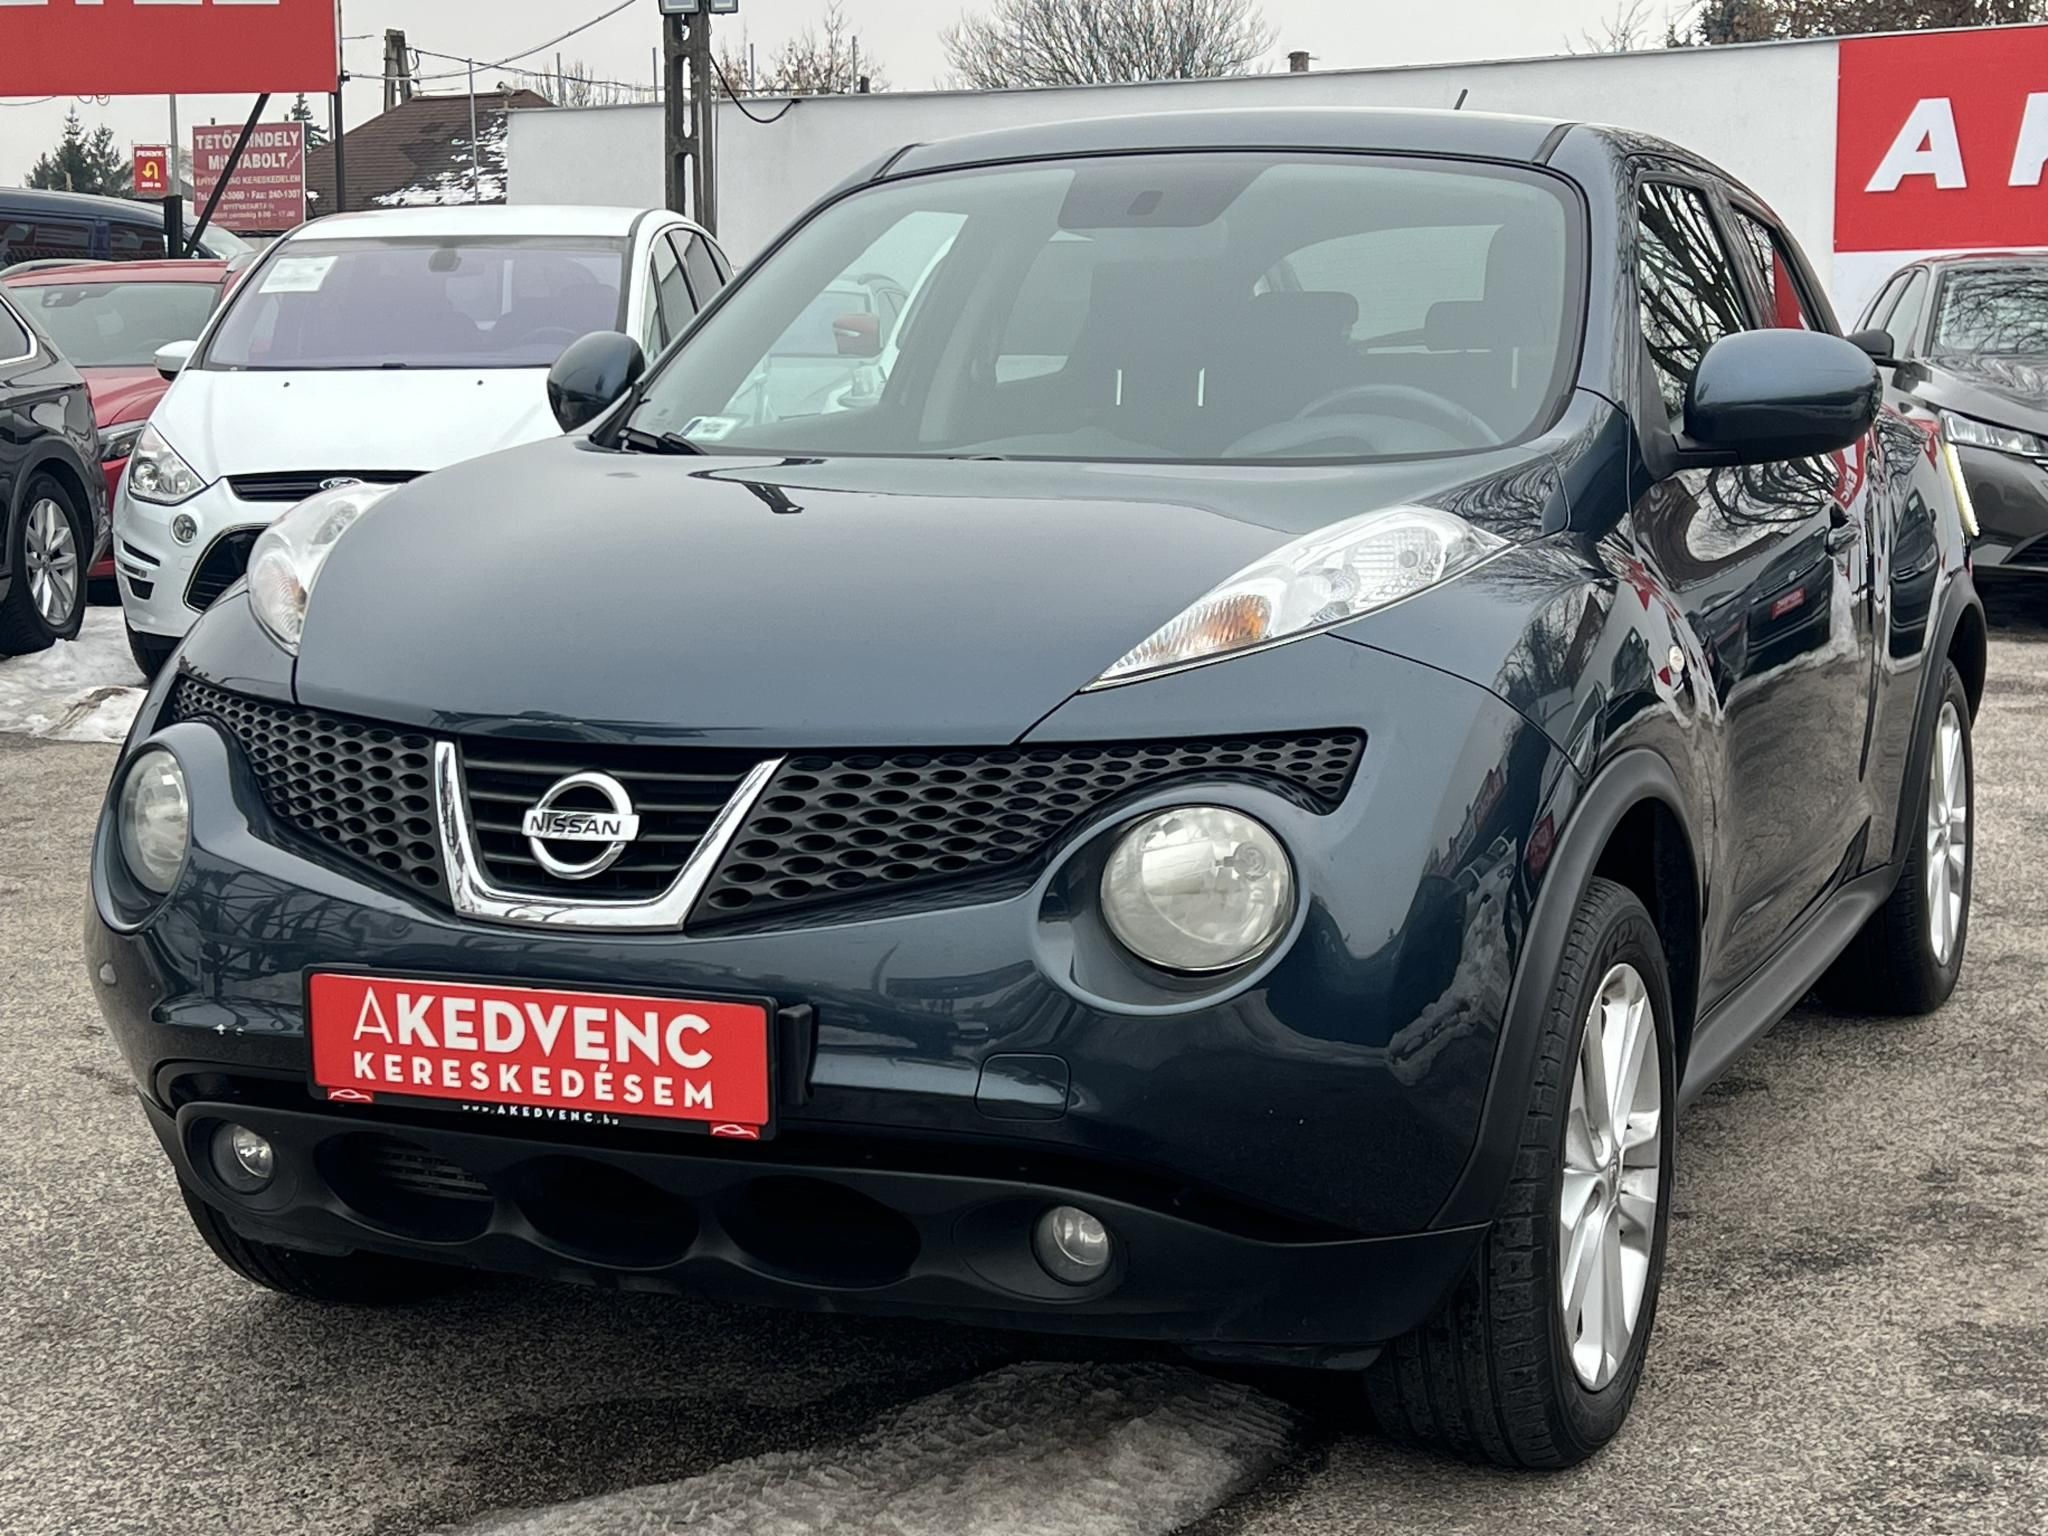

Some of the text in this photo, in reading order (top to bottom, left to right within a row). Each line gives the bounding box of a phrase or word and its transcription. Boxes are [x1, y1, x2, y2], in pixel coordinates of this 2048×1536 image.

[196, 130, 299, 149] TETŐZINDELY
[529, 814, 622, 836] NISSAN
[353, 1050, 714, 1110] KERESKEDÉSEM
[462, 1104, 619, 1126] www.AKEDVENC.hu
